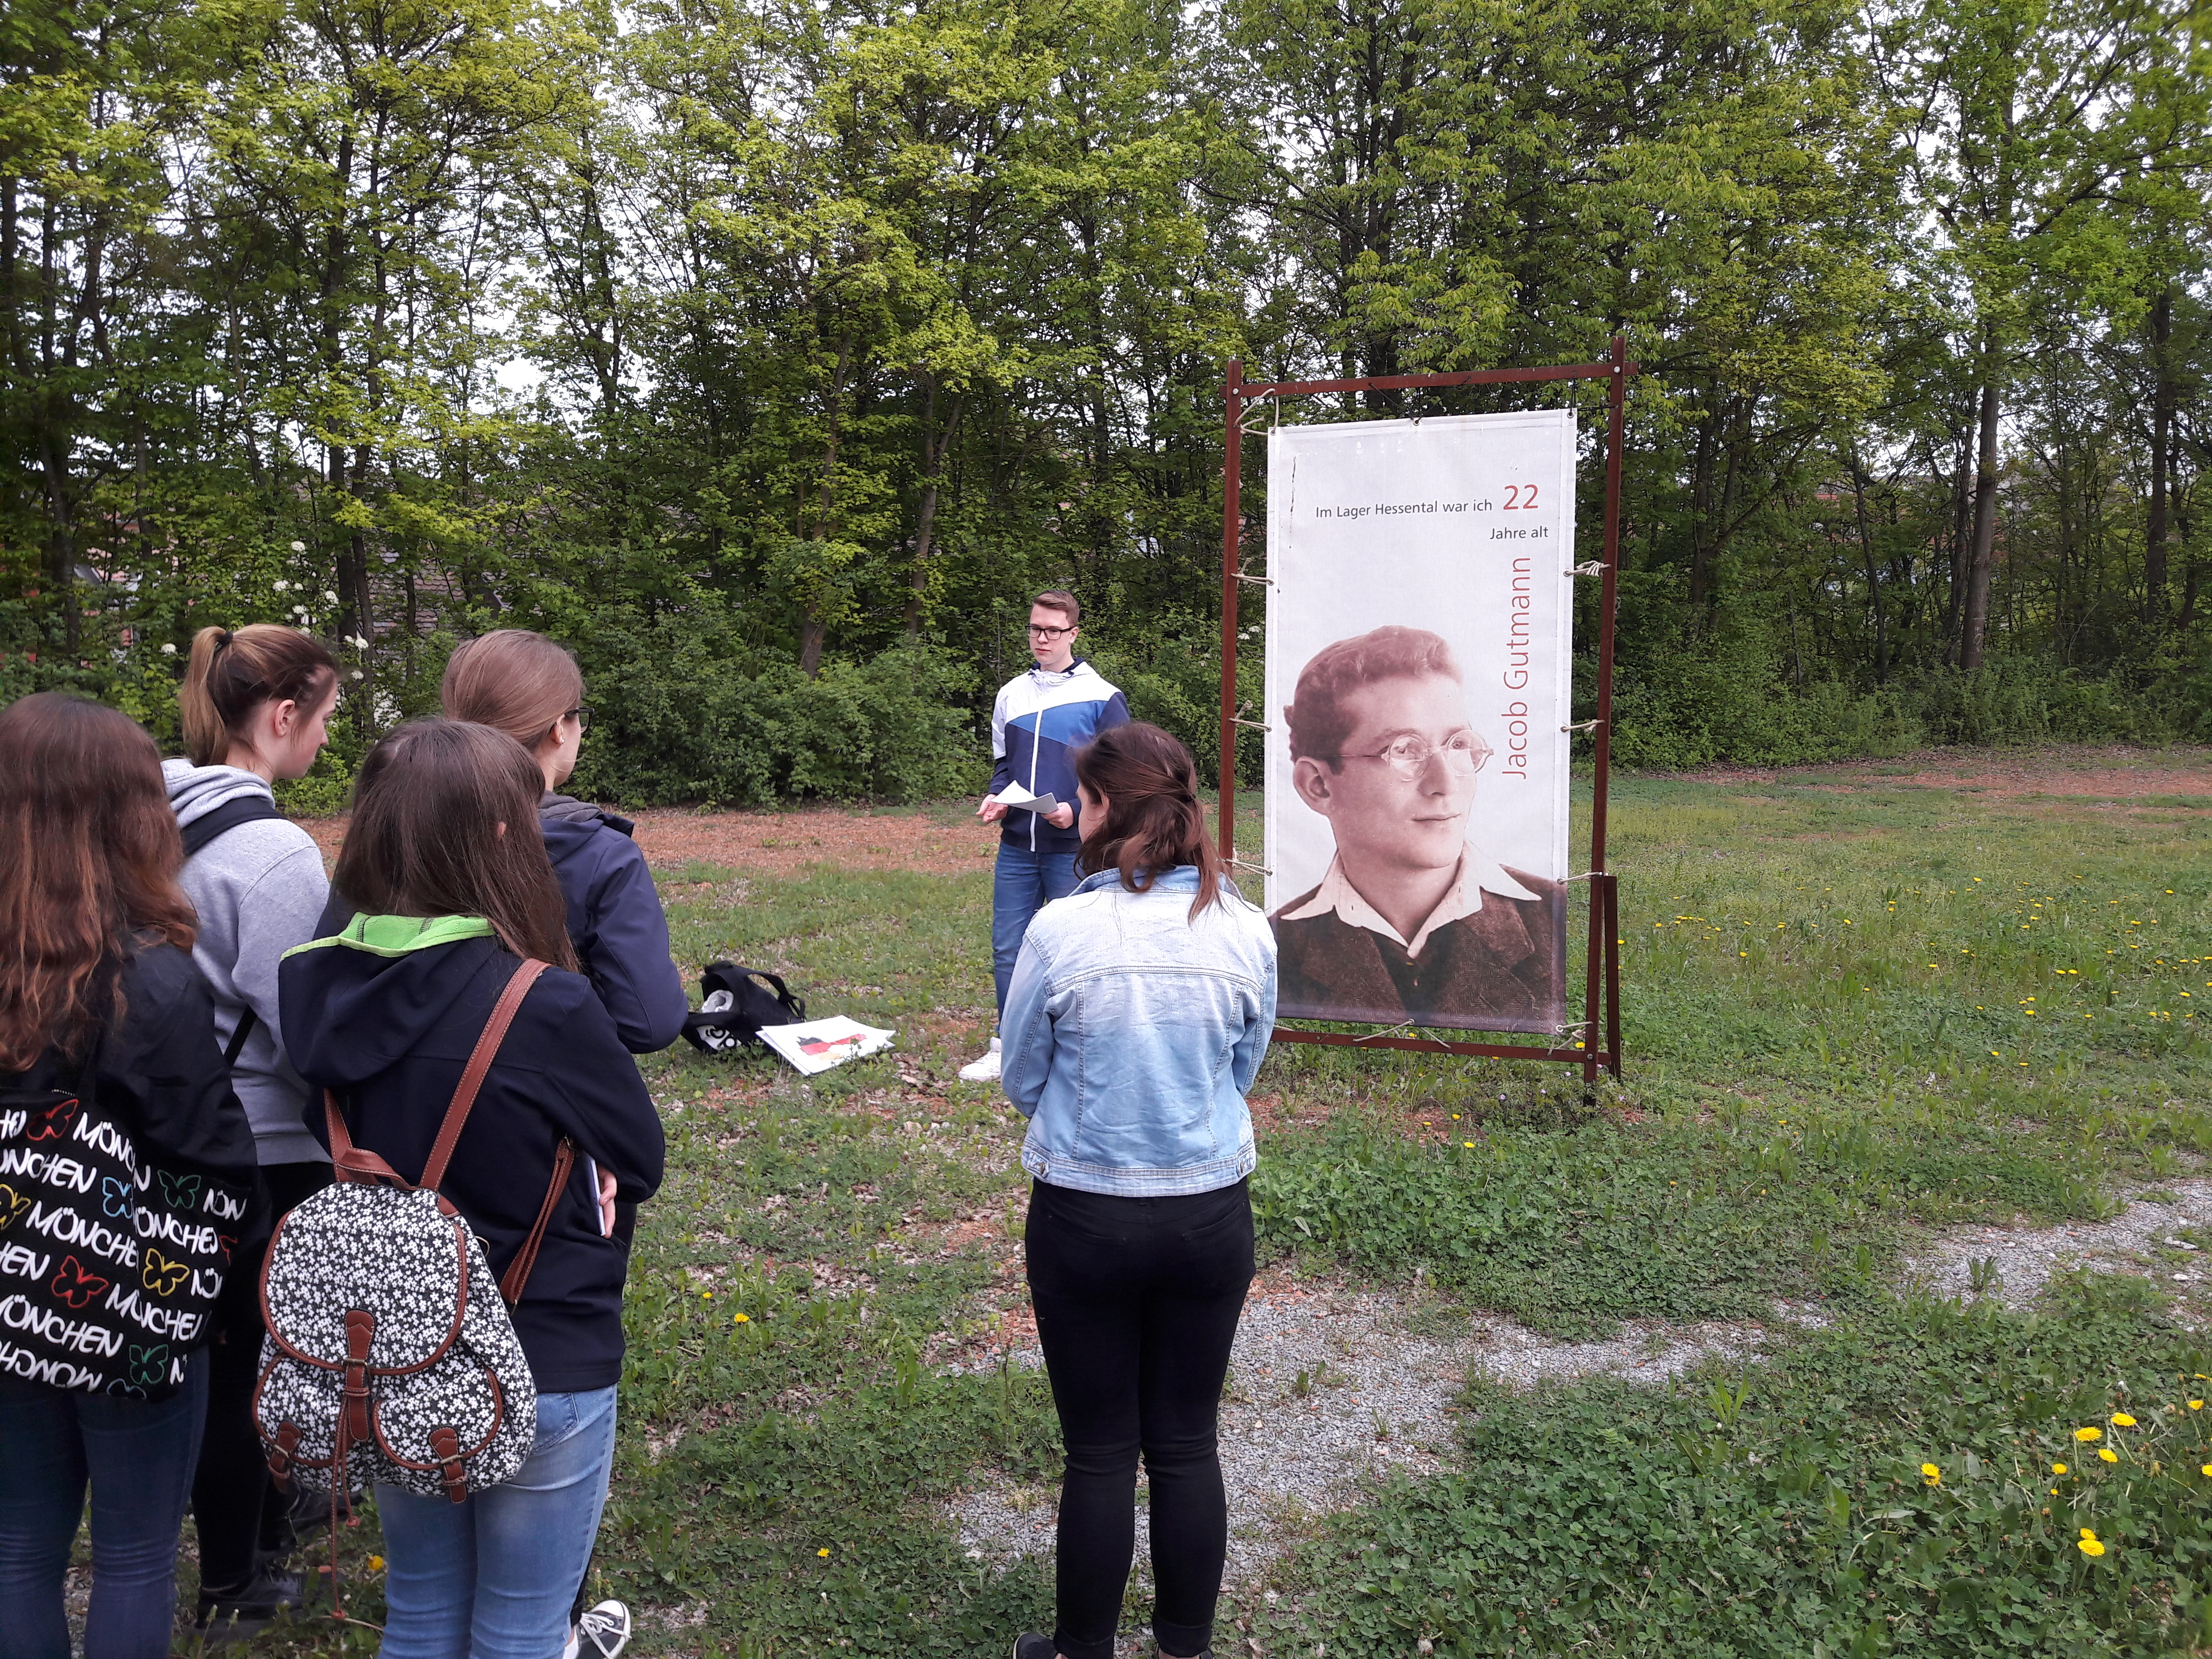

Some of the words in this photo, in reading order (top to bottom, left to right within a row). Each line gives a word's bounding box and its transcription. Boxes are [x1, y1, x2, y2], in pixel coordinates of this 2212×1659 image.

[1316, 506, 1332, 518] Im
[1336, 505, 1371, 520] Lager
[1375, 500, 1438, 515] Hessental
[1443, 503, 1469, 513] war
[1473, 498, 1492, 512] ich
[1503, 483, 1539, 511] 22
[1489, 526, 1527, 540] Jahre
[1531, 525, 1549, 539] alt
[1503, 557, 1531, 690] Gutmann
[1501, 701, 1528, 779] Jacob
